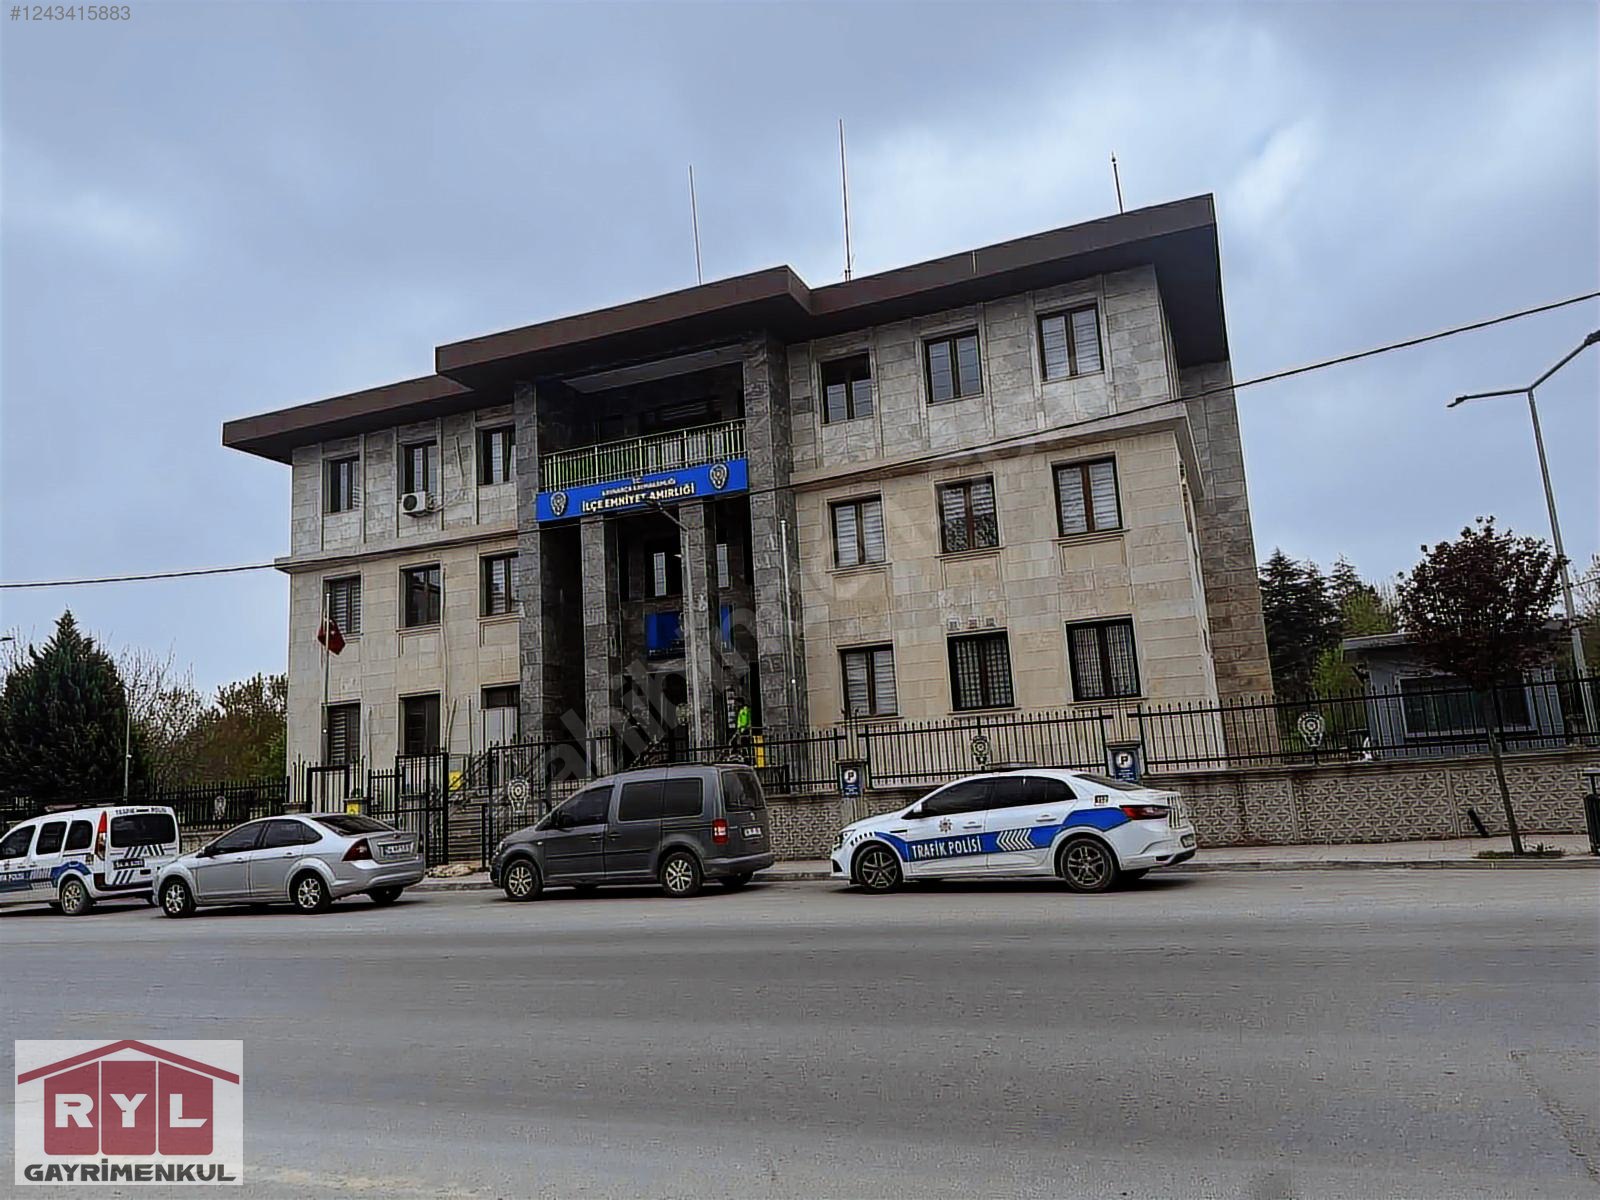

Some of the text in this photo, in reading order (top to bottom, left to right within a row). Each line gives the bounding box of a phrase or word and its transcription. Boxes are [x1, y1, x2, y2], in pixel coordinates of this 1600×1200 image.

[582, 500, 604, 513] İLÇE
[604, 492, 647, 508] EMNİYET
[912, 835, 982, 859] TRAFİK POLİSİ
